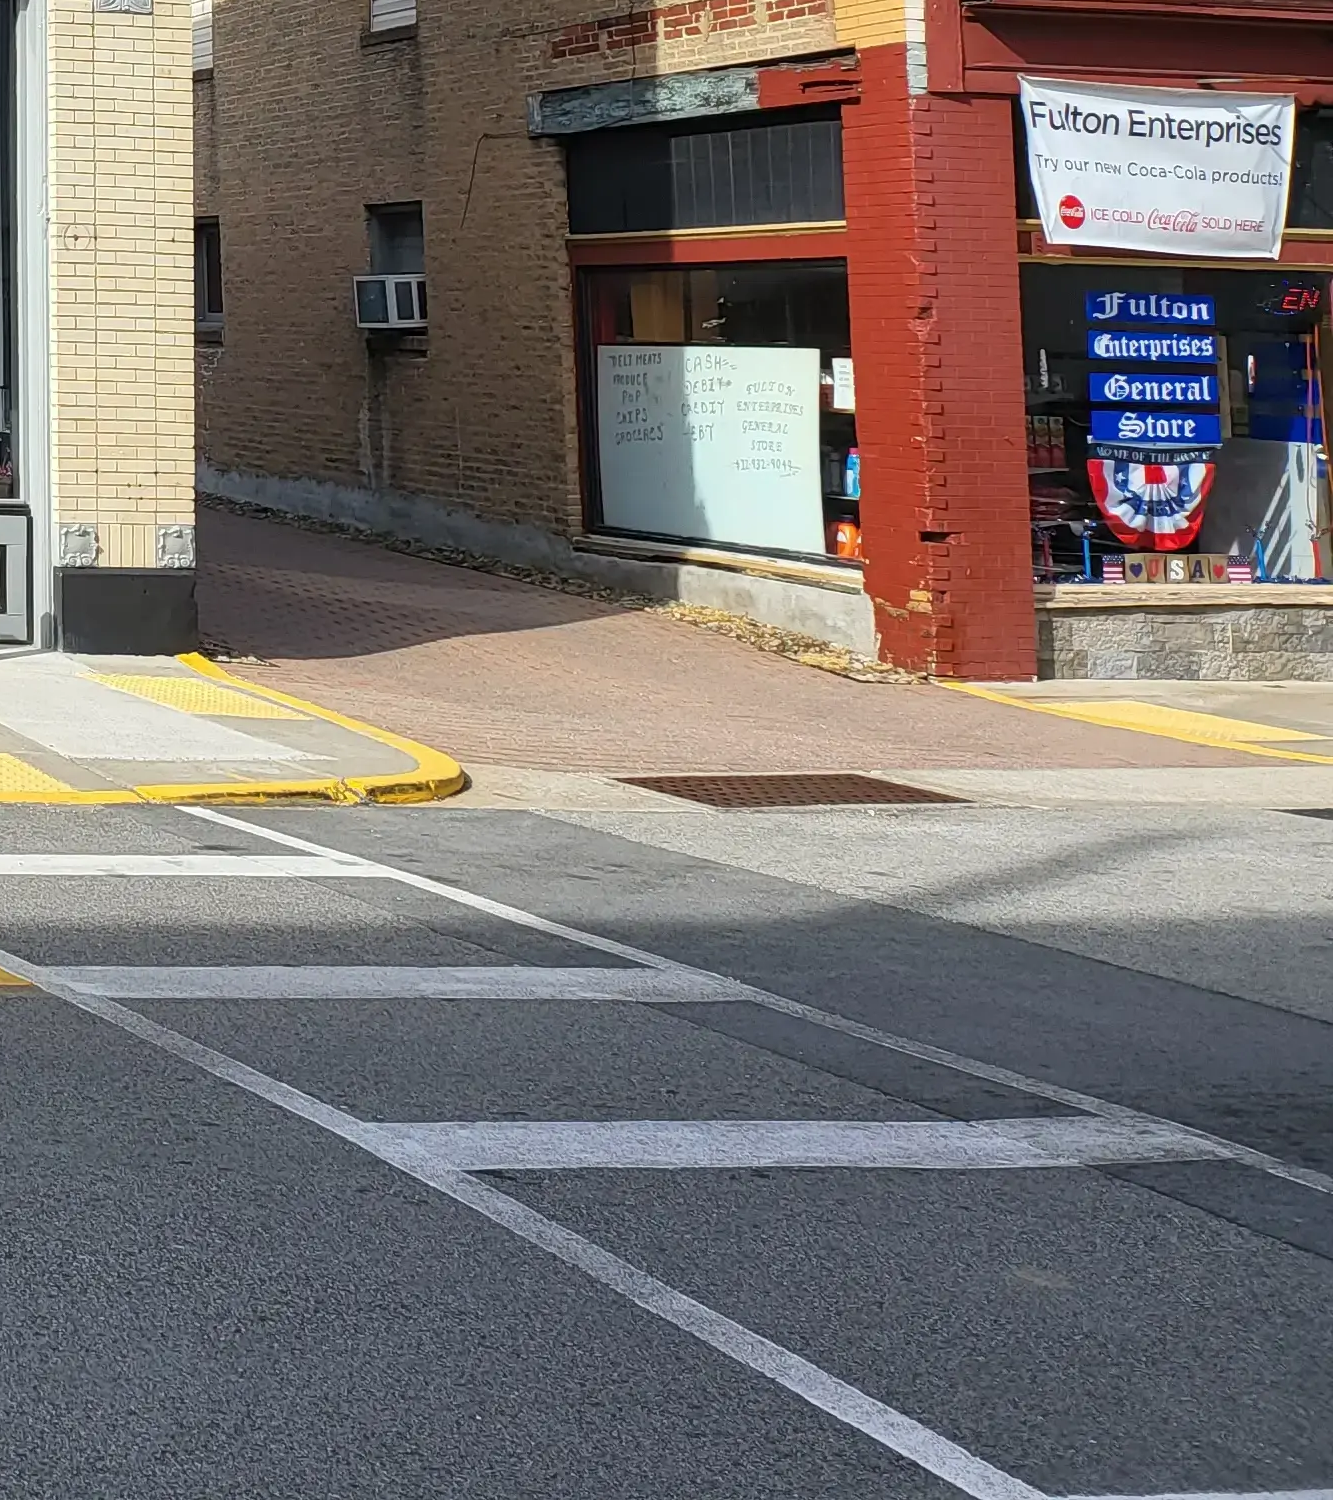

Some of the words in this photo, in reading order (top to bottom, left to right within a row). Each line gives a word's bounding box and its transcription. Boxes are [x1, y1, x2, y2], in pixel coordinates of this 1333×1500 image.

[1029, 101, 1119, 135] Fulton
[1127, 109, 1281, 147] Enterprises
[1035, 154, 1058, 172] Try
[1064, 159, 1089, 171] our
[1095, 161, 1121, 176] new
[1127, 162, 1206, 180] Coca-Cola
[1211, 168, 1283, 186] products!
[1091, 208, 1109, 221] ICE
[1112, 209, 1144, 223] COLD
[1147, 207, 1200, 232] Coca-Cola
[1202, 216, 1231, 230] SOLD
[1234, 219, 1265, 233] HERE
[1093, 292, 1210, 320] Fulton
[1094, 333, 1214, 360] Enterprises
[636, 353, 662, 367] MEATS
[686, 354, 722, 373] CASH
[683, 377, 723, 396] DEBIT
[1104, 374, 1211, 401] General
[623, 390, 641, 404] POP
[617, 408, 648, 425] CHIPS
[681, 400, 724, 416] CREDIT
[737, 401, 804, 416] ENTERPRISES
[742, 420, 788, 434] GENERAL
[1118, 412, 1196, 439] Store
[751, 440, 783, 452] STORE
[1132, 451, 1145, 462] OF
